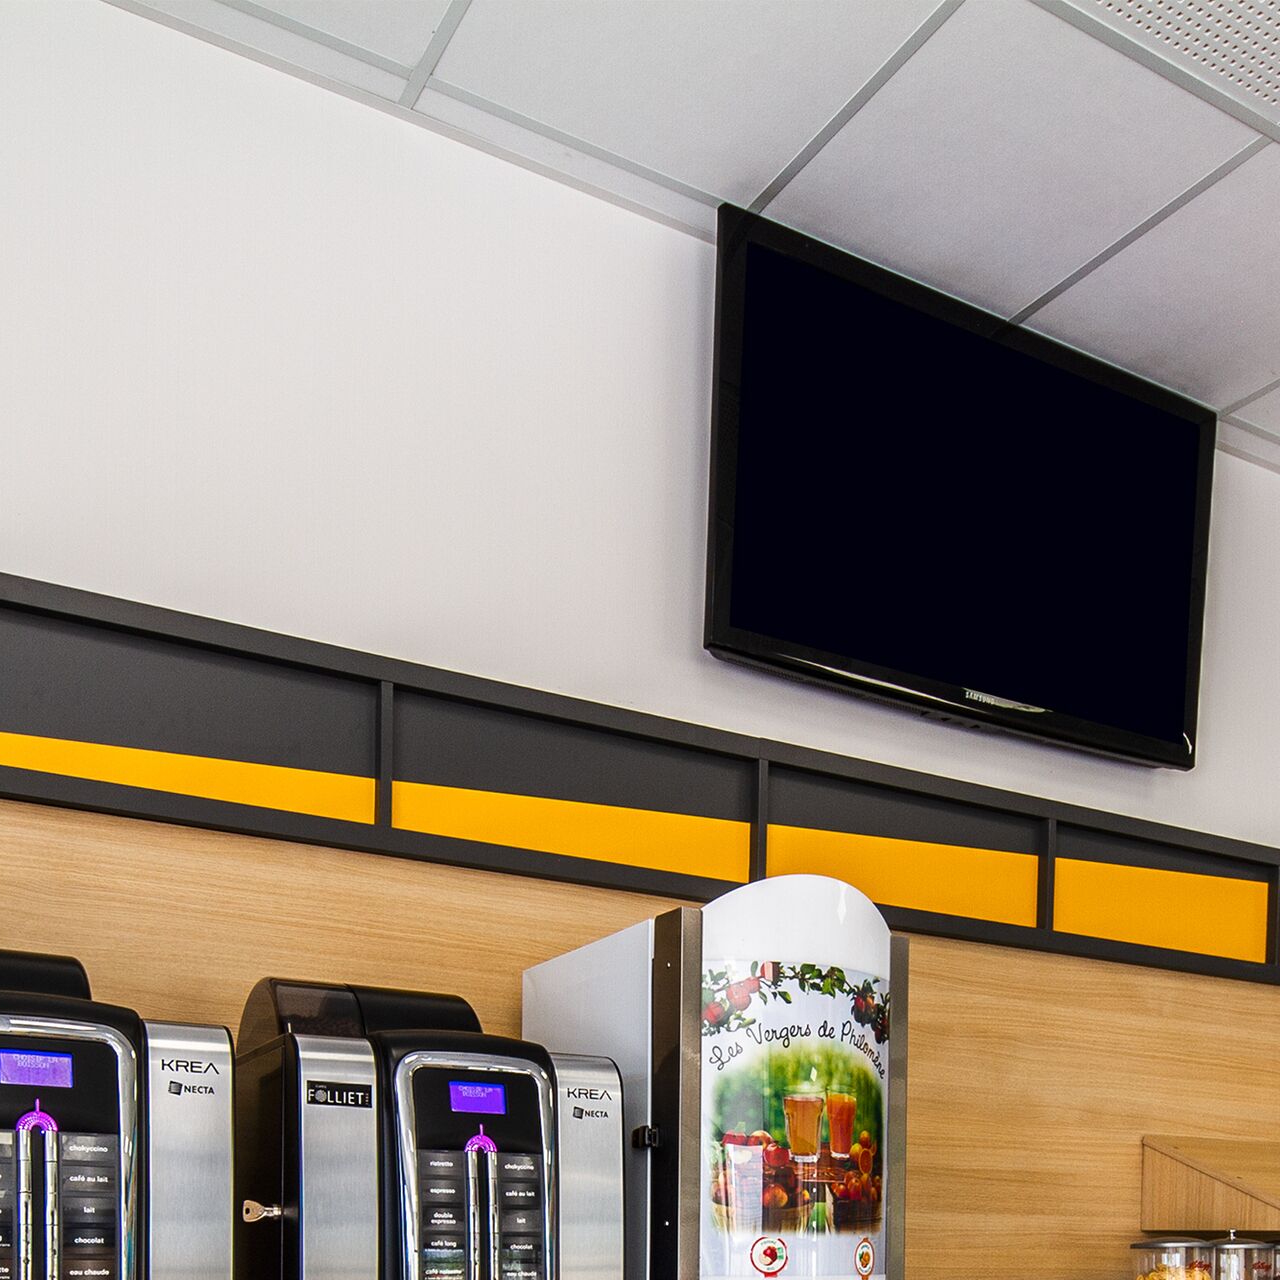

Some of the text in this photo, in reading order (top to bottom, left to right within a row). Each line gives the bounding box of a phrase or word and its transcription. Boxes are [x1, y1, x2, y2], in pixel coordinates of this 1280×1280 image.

[709, 1020, 886, 1079] Les Vergers de Philomène
[184, 1085, 215, 1094] NECTA
[308, 1089, 364, 1105] FOLLIET
[584, 1110, 608, 1118] NECTA
[69, 1174, 86, 1182] café
[96, 1175, 108, 1183] lait
[74, 1236, 105, 1244] chocolat
[84, 1268, 110, 1276] chaude
